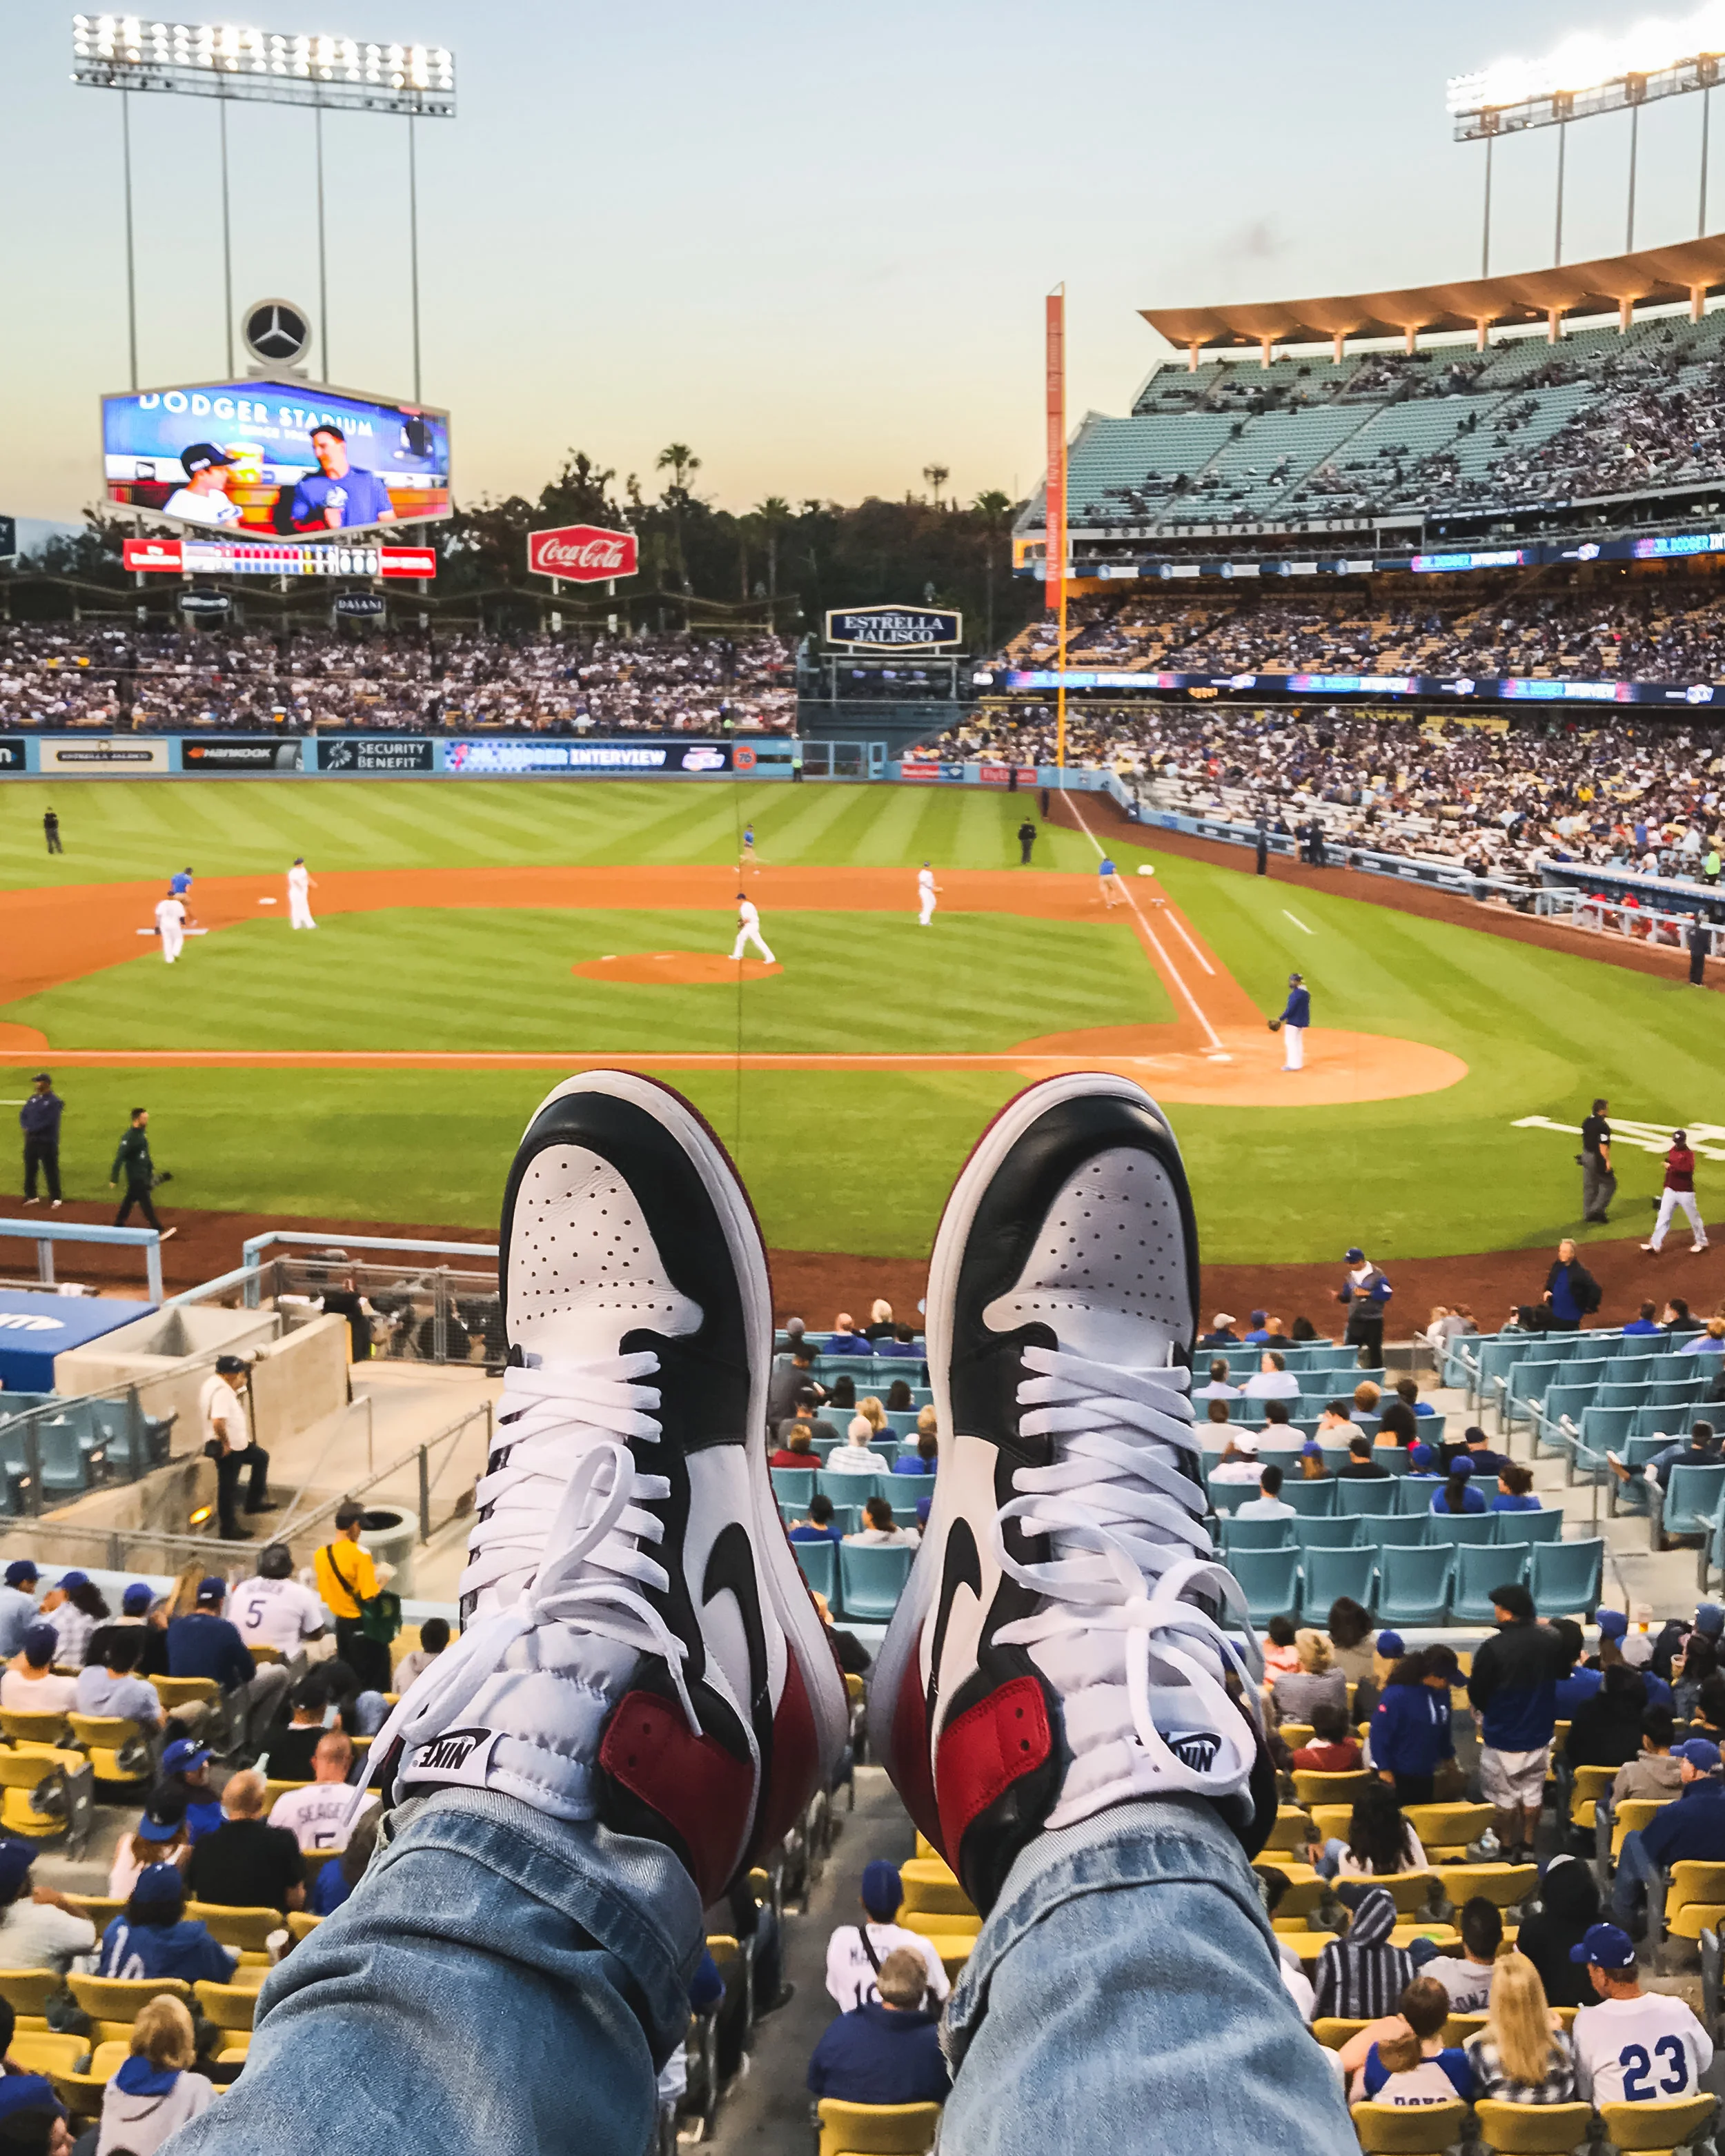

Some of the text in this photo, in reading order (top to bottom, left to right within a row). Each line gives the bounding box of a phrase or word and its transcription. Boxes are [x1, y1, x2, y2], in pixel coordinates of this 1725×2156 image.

[139, 390, 269, 424] DODGER
[279, 406, 373, 437] STADIUM
[844, 615, 945, 630] ESTRELLA
[854, 629, 934, 643] JALISCO
[357, 742, 426, 755] SECURITY
[570, 748, 667, 766] INTERVIEW
[357, 755, 417, 769] BENEFIT
[245, 1599, 266, 1629] 5
[418, 1741, 474, 1770] NIKE
[297, 1801, 348, 1824] SEAGE
[1619, 2034, 1689, 2101] 23
